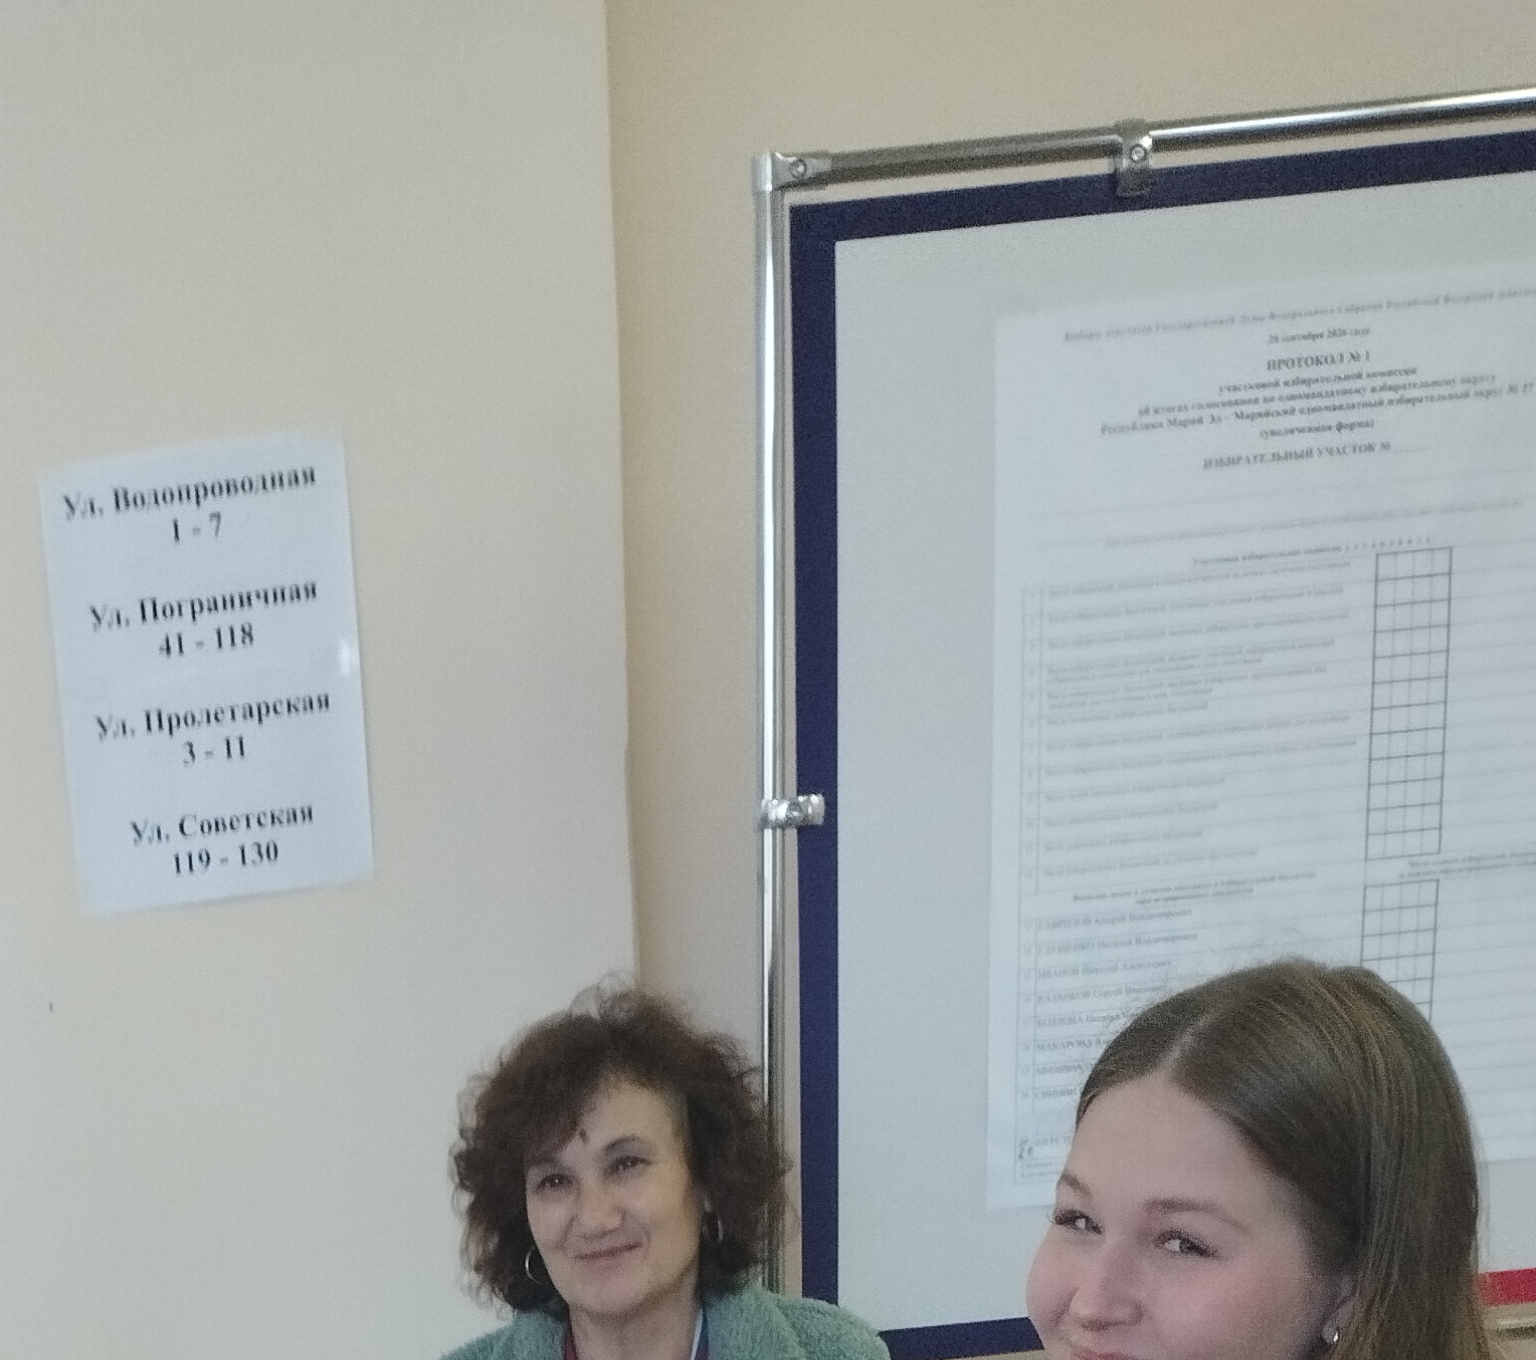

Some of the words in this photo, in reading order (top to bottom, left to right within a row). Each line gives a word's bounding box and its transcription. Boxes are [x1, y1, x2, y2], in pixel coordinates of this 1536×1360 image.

[1267, 352, 1345, 371] ПРОТОКОЛ
[112, 465, 316, 513] Водопроводная
[172, 517, 180, 544] 1
[209, 510, 222, 539] 7
[138, 580, 317, 626] Пограничная
[158, 631, 185, 660] 41
[215, 620, 255, 650] 118
[95, 713, 136, 743] Ул.
[143, 691, 331, 738] Пролетарская
[182, 739, 196, 768] 3
[223, 734, 246, 762] 11
[129, 818, 171, 847] Ул.
[178, 803, 314, 840] Советская
[173, 847, 211, 878] 119
[238, 838, 280, 868] 130
